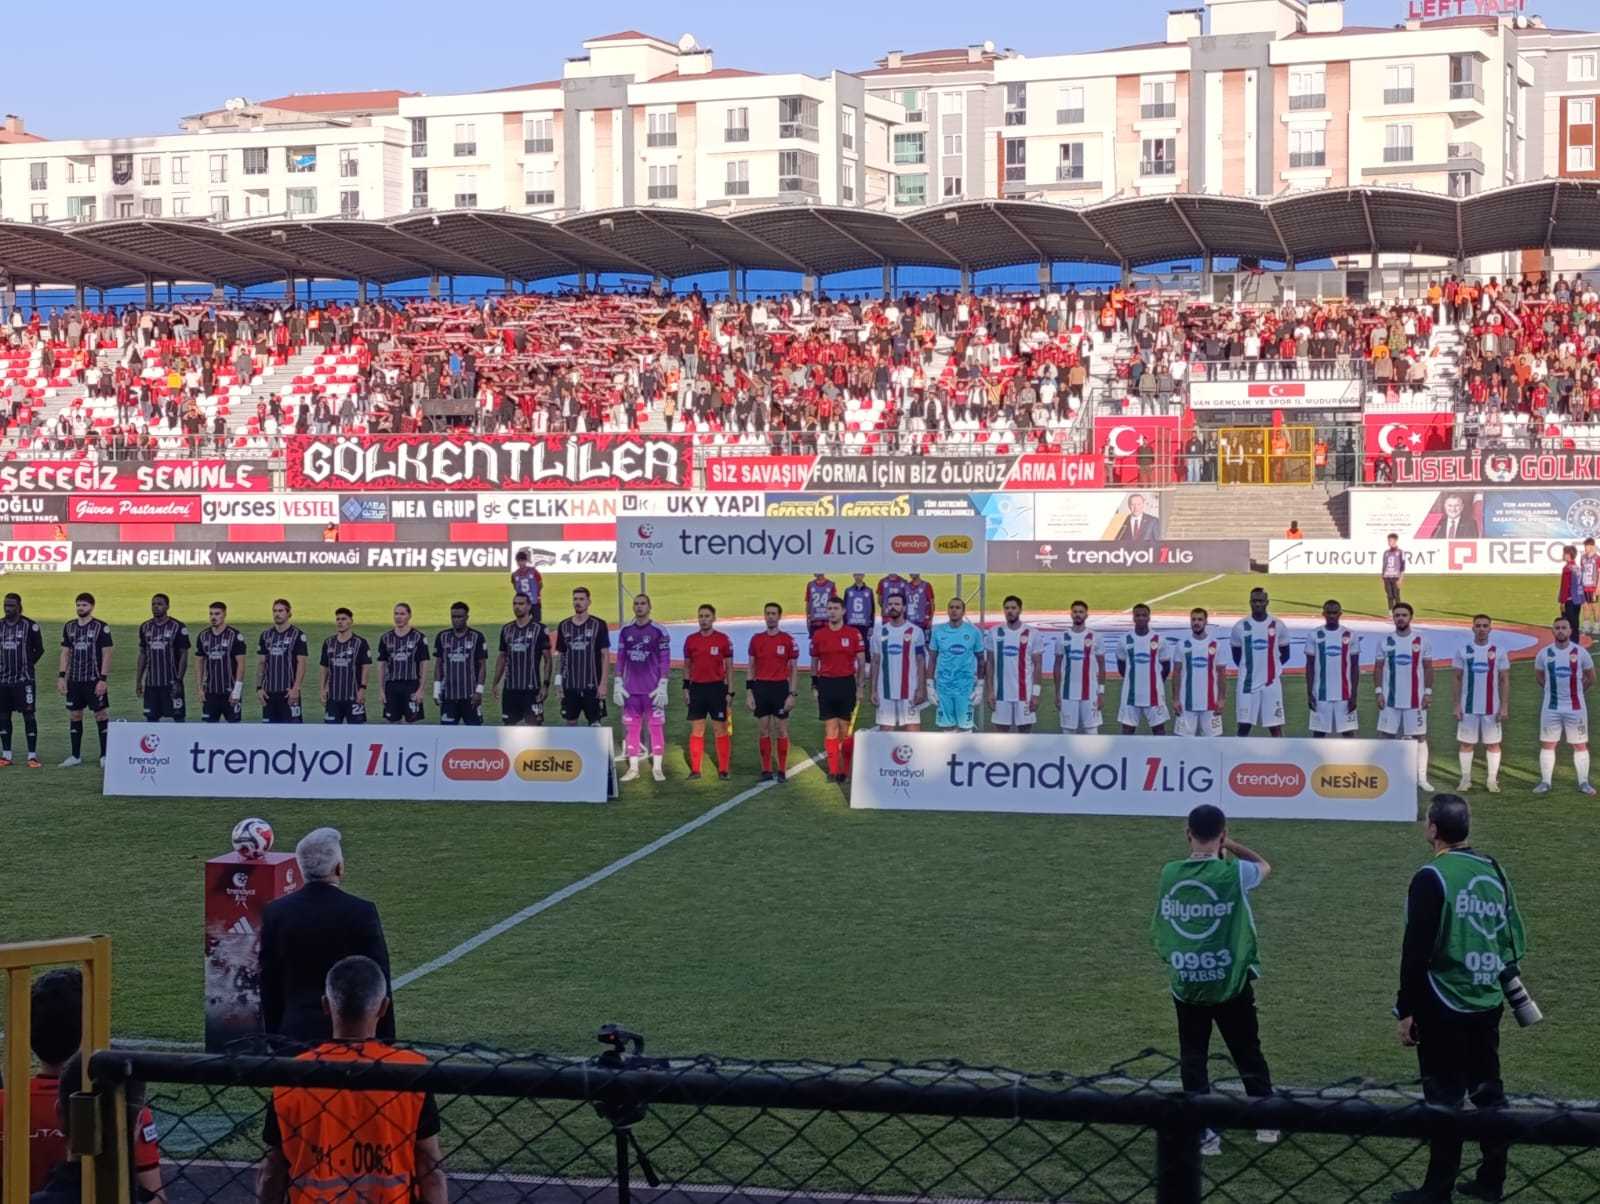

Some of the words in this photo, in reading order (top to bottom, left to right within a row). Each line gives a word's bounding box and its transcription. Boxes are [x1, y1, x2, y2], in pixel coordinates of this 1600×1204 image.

[303, 436, 680, 485] GÖLKENTLİLER
[1396, 449, 1482, 483] LİSELİ
[137, 461, 254, 491] SENİNLE
[712, 461, 737, 483] SİZ
[741, 464, 808, 487] SAVAŞIN
[813, 464, 867, 483] FORMA
[872, 461, 906, 487] İÇİN
[910, 461, 937, 483] BİZ
[941, 462, 1006, 483] ÖLÜRÜZ
[1010, 462, 1056, 482] ARMA
[1061, 459, 1096, 485] İÇİN
[76, 500, 114, 518] Güven
[119, 500, 193, 517] Pastaneleri
[283, 501, 337, 517] VESTEL
[392, 500, 426, 518] MEA
[433, 500, 475, 518] GRUP
[667, 496, 709, 513] UKY
[714, 496, 759, 513] YAPI
[679, 529, 812, 561] trendyol
[893, 539, 928, 551] trendyol
[1067, 547, 1153, 567] trendyol
[1304, 551, 1378, 565] TURGUT
[521, 578, 530, 593] 5
[812, 592, 829, 608] 24
[853, 597, 864, 612] 6
[128, 756, 170, 768] trendyol
[190, 741, 353, 783] trendyol
[448, 758, 504, 773] trendyol
[522, 756, 574, 773] NESİNE
[879, 767, 925, 779] trendyol
[946, 753, 1128, 798] trendyol
[1236, 771, 1299, 788] trendyol
[1320, 771, 1379, 789] NESİNE
[1161, 895, 1235, 922] Bilyoner
[1171, 948, 1232, 970] 0963
[1179, 967, 1226, 983] PRESS
